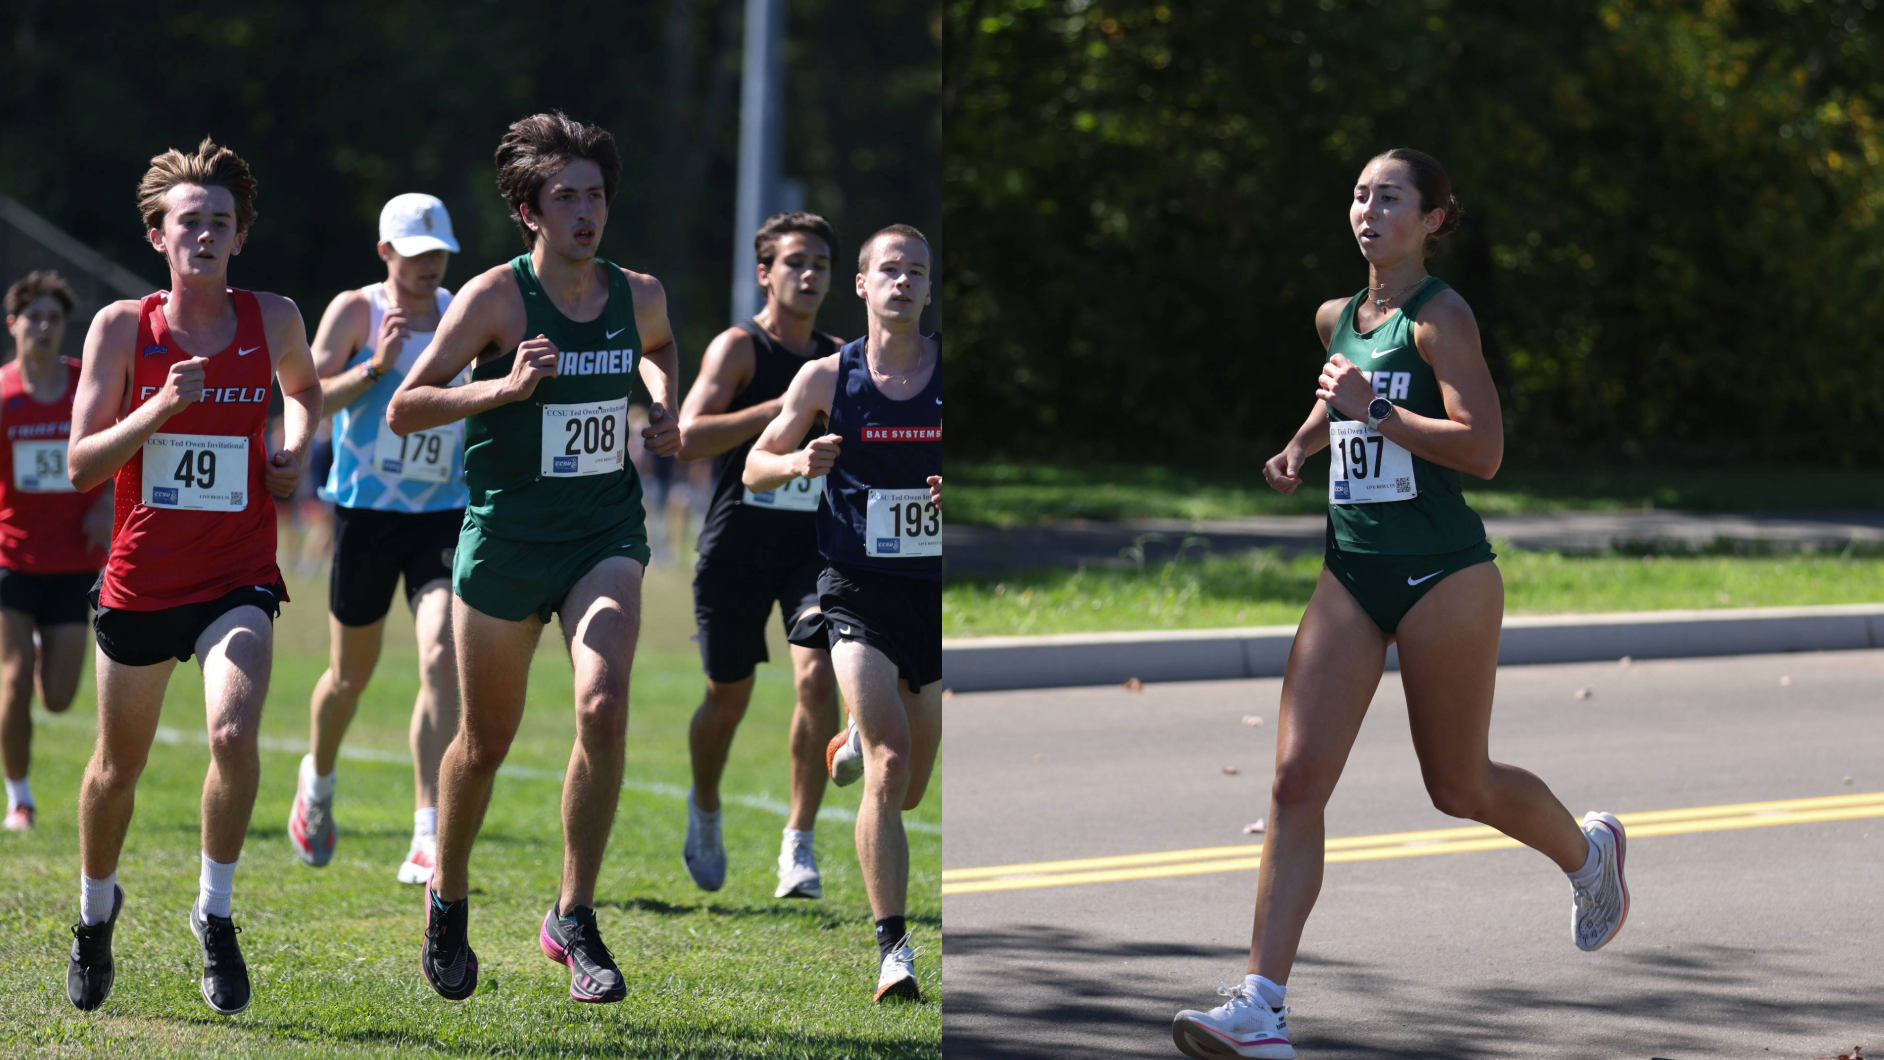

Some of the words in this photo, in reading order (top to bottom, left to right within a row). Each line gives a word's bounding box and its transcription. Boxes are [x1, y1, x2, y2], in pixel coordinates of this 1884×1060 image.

[140, 385, 267, 403] FFIELD
[1361, 371, 1411, 400] ER
[582, 406, 600, 416] Owen
[601, 403, 626, 413] Invitational
[147, 438, 168, 446] CCSU
[170, 439, 184, 447] Ted
[207, 441, 245, 450] Invitational
[400, 432, 442, 465] 179
[565, 414, 616, 456] 208
[866, 430, 888, 439] BAE
[891, 430, 942, 438] SYSTEMS
[36, 449, 62, 478] 53
[173, 449, 216, 490] 49
[1338, 435, 1384, 480] 197
[889, 502, 939, 538] 193
